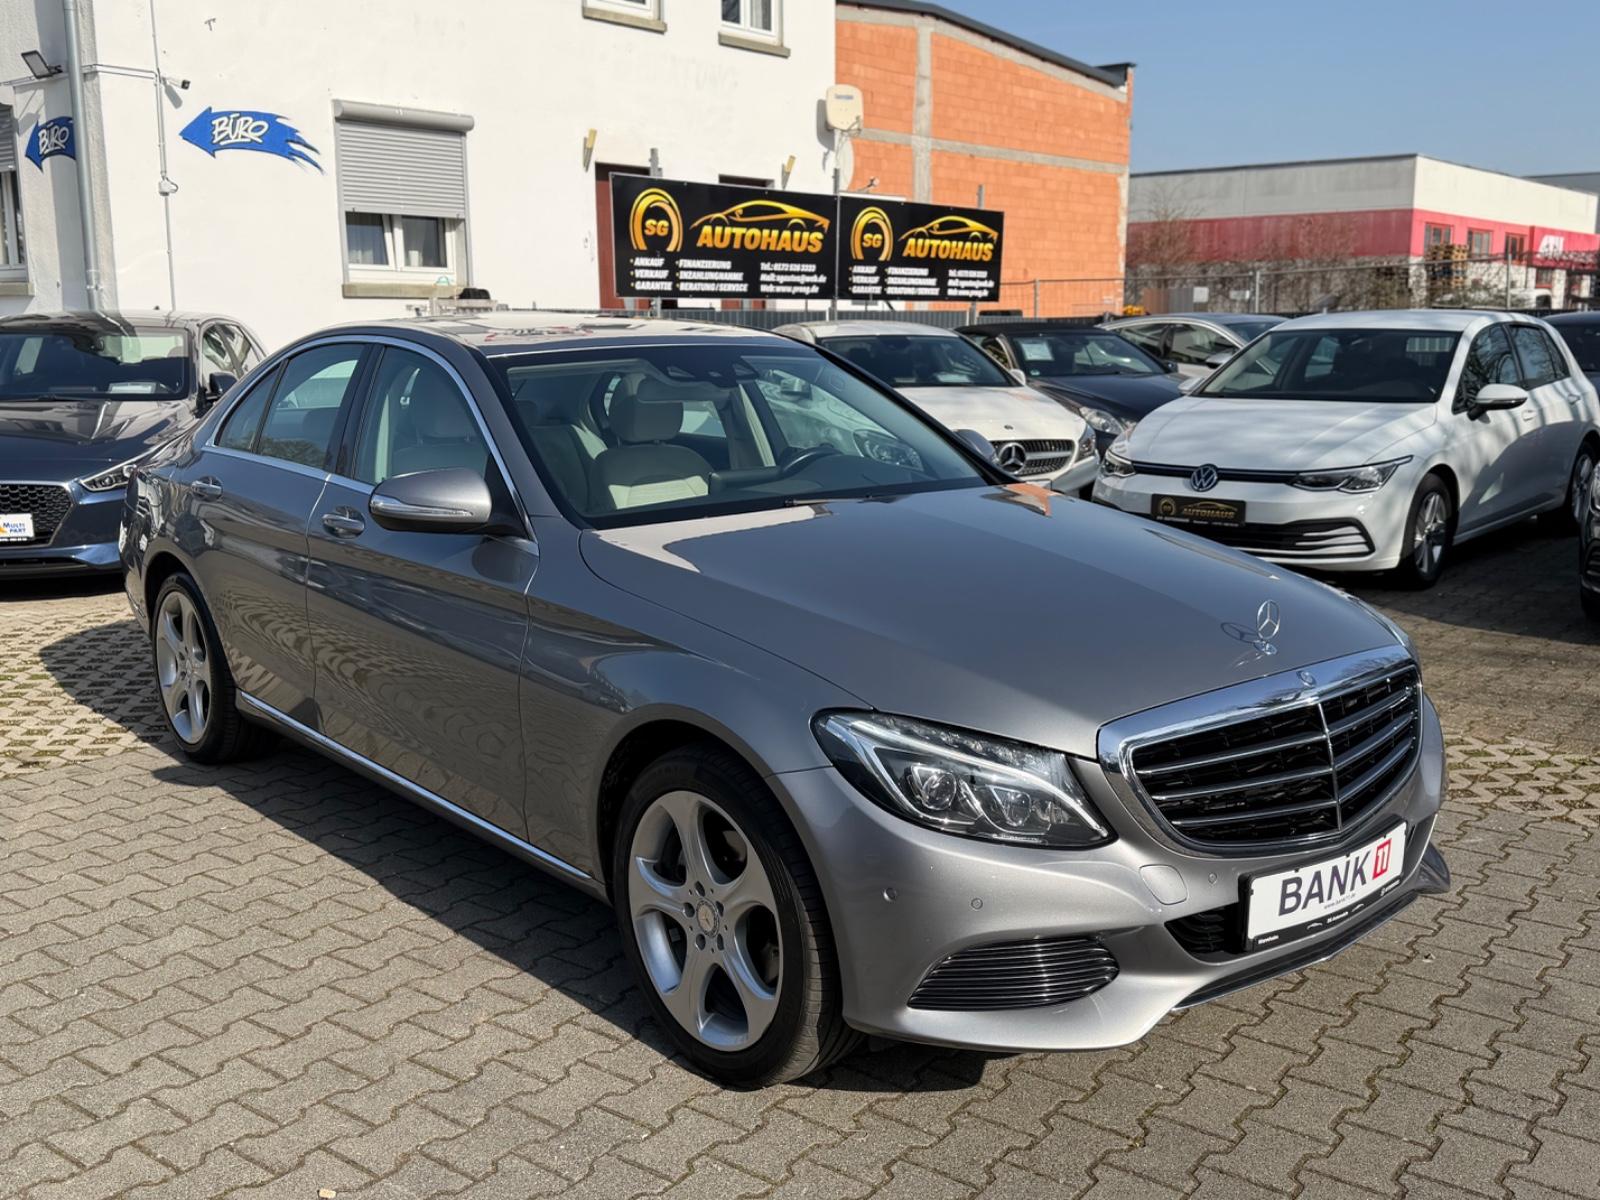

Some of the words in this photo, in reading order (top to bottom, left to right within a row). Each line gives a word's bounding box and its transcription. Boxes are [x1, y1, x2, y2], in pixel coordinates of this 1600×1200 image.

[212, 113, 269, 146] BÜRO
[37, 122, 70, 155] BÜRO
[644, 219, 669, 237] SG
[696, 224, 824, 253] AUTOHAUS
[862, 233, 883, 248] SG
[902, 238, 994, 262] AUTOHAUS
[634, 257, 665, 267] ANKAUF
[679, 259, 732, 270] FINANZIERUNG
[634, 269, 669, 279] VERKAUF
[635, 281, 673, 291] GARANTIE
[1183, 508, 1235, 519] AUTOHAUS
[1278, 850, 1372, 917] BANK
